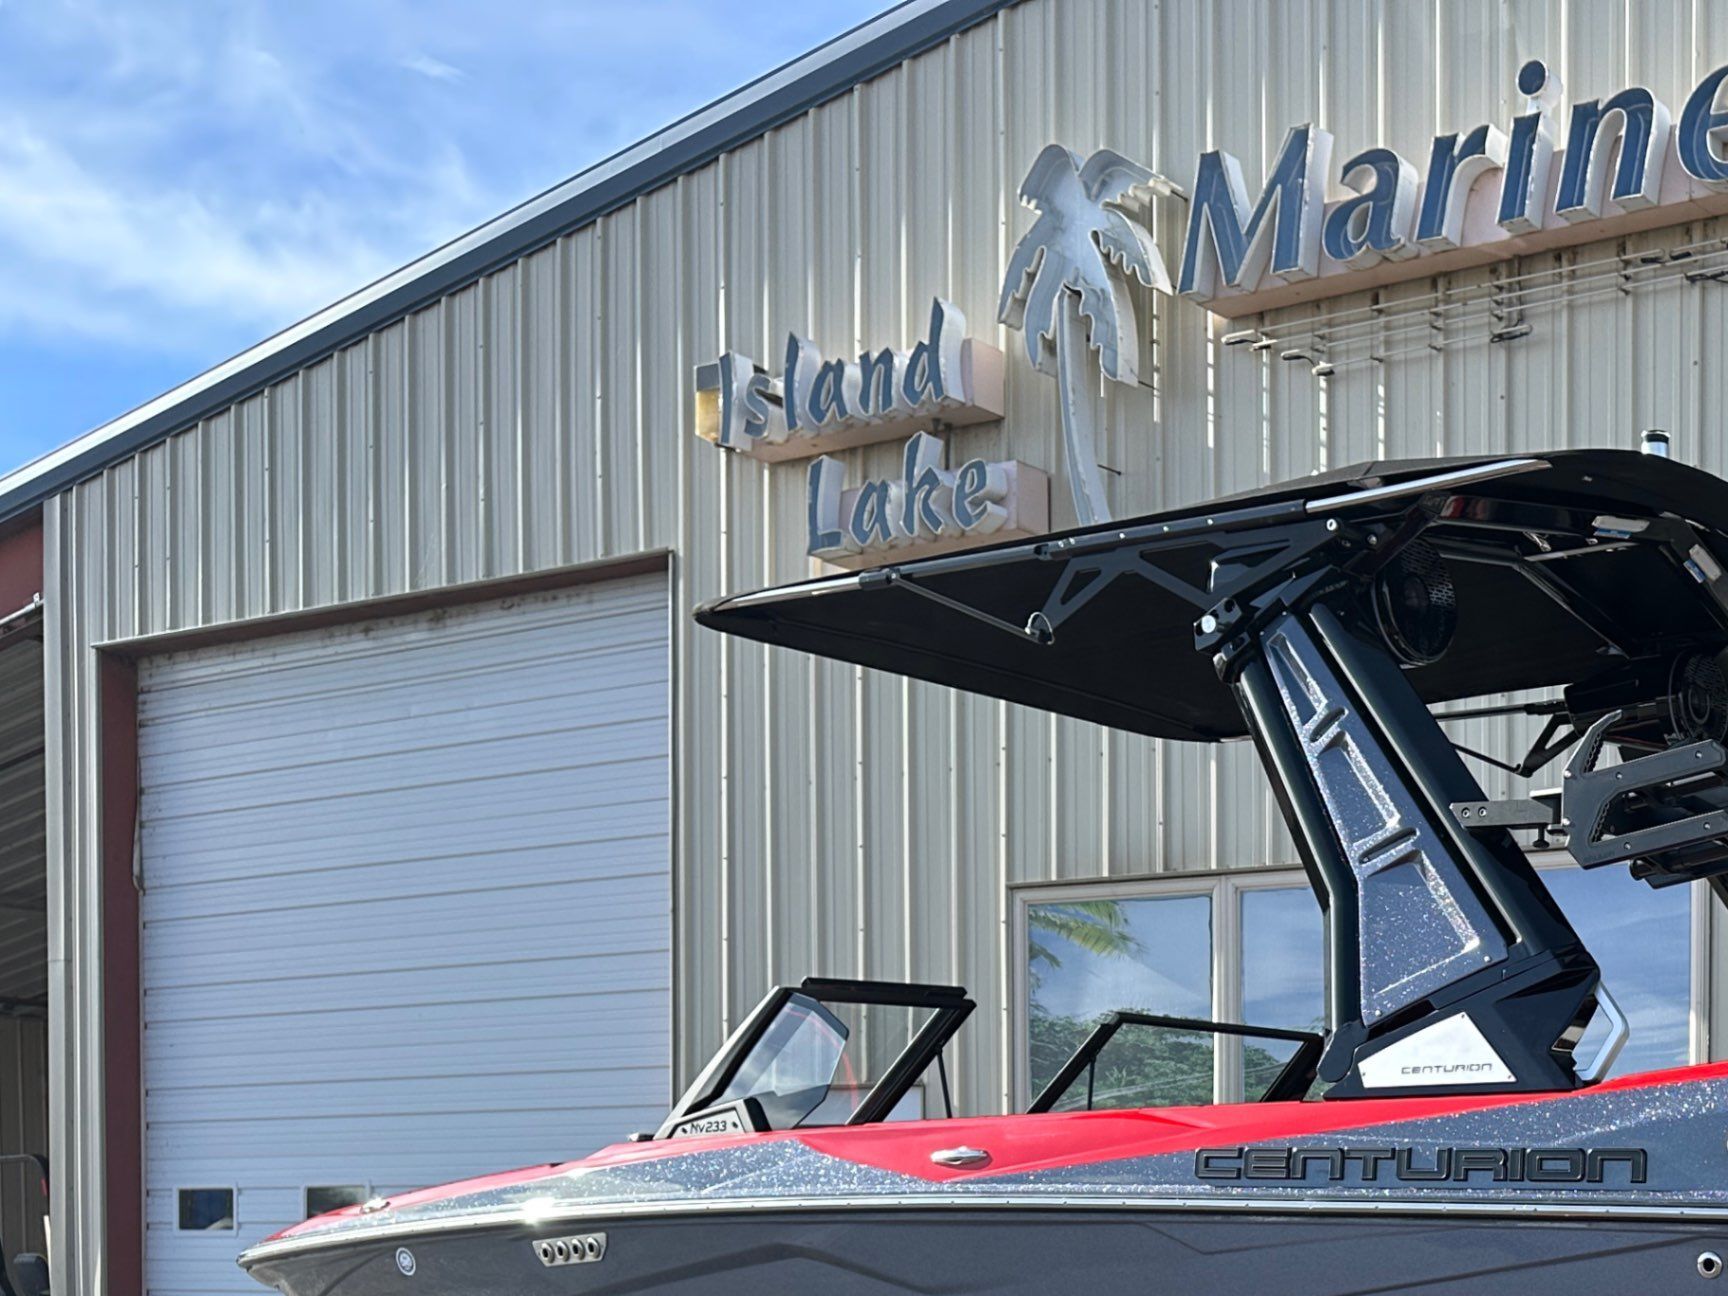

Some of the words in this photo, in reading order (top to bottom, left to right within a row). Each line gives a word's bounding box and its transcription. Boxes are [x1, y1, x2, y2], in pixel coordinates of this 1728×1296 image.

[718, 297, 966, 450] Island
[807, 432, 1004, 560] Lake
[1400, 1062, 1494, 1076] CENTURION
[1193, 1146, 1648, 1184] CENTURION
